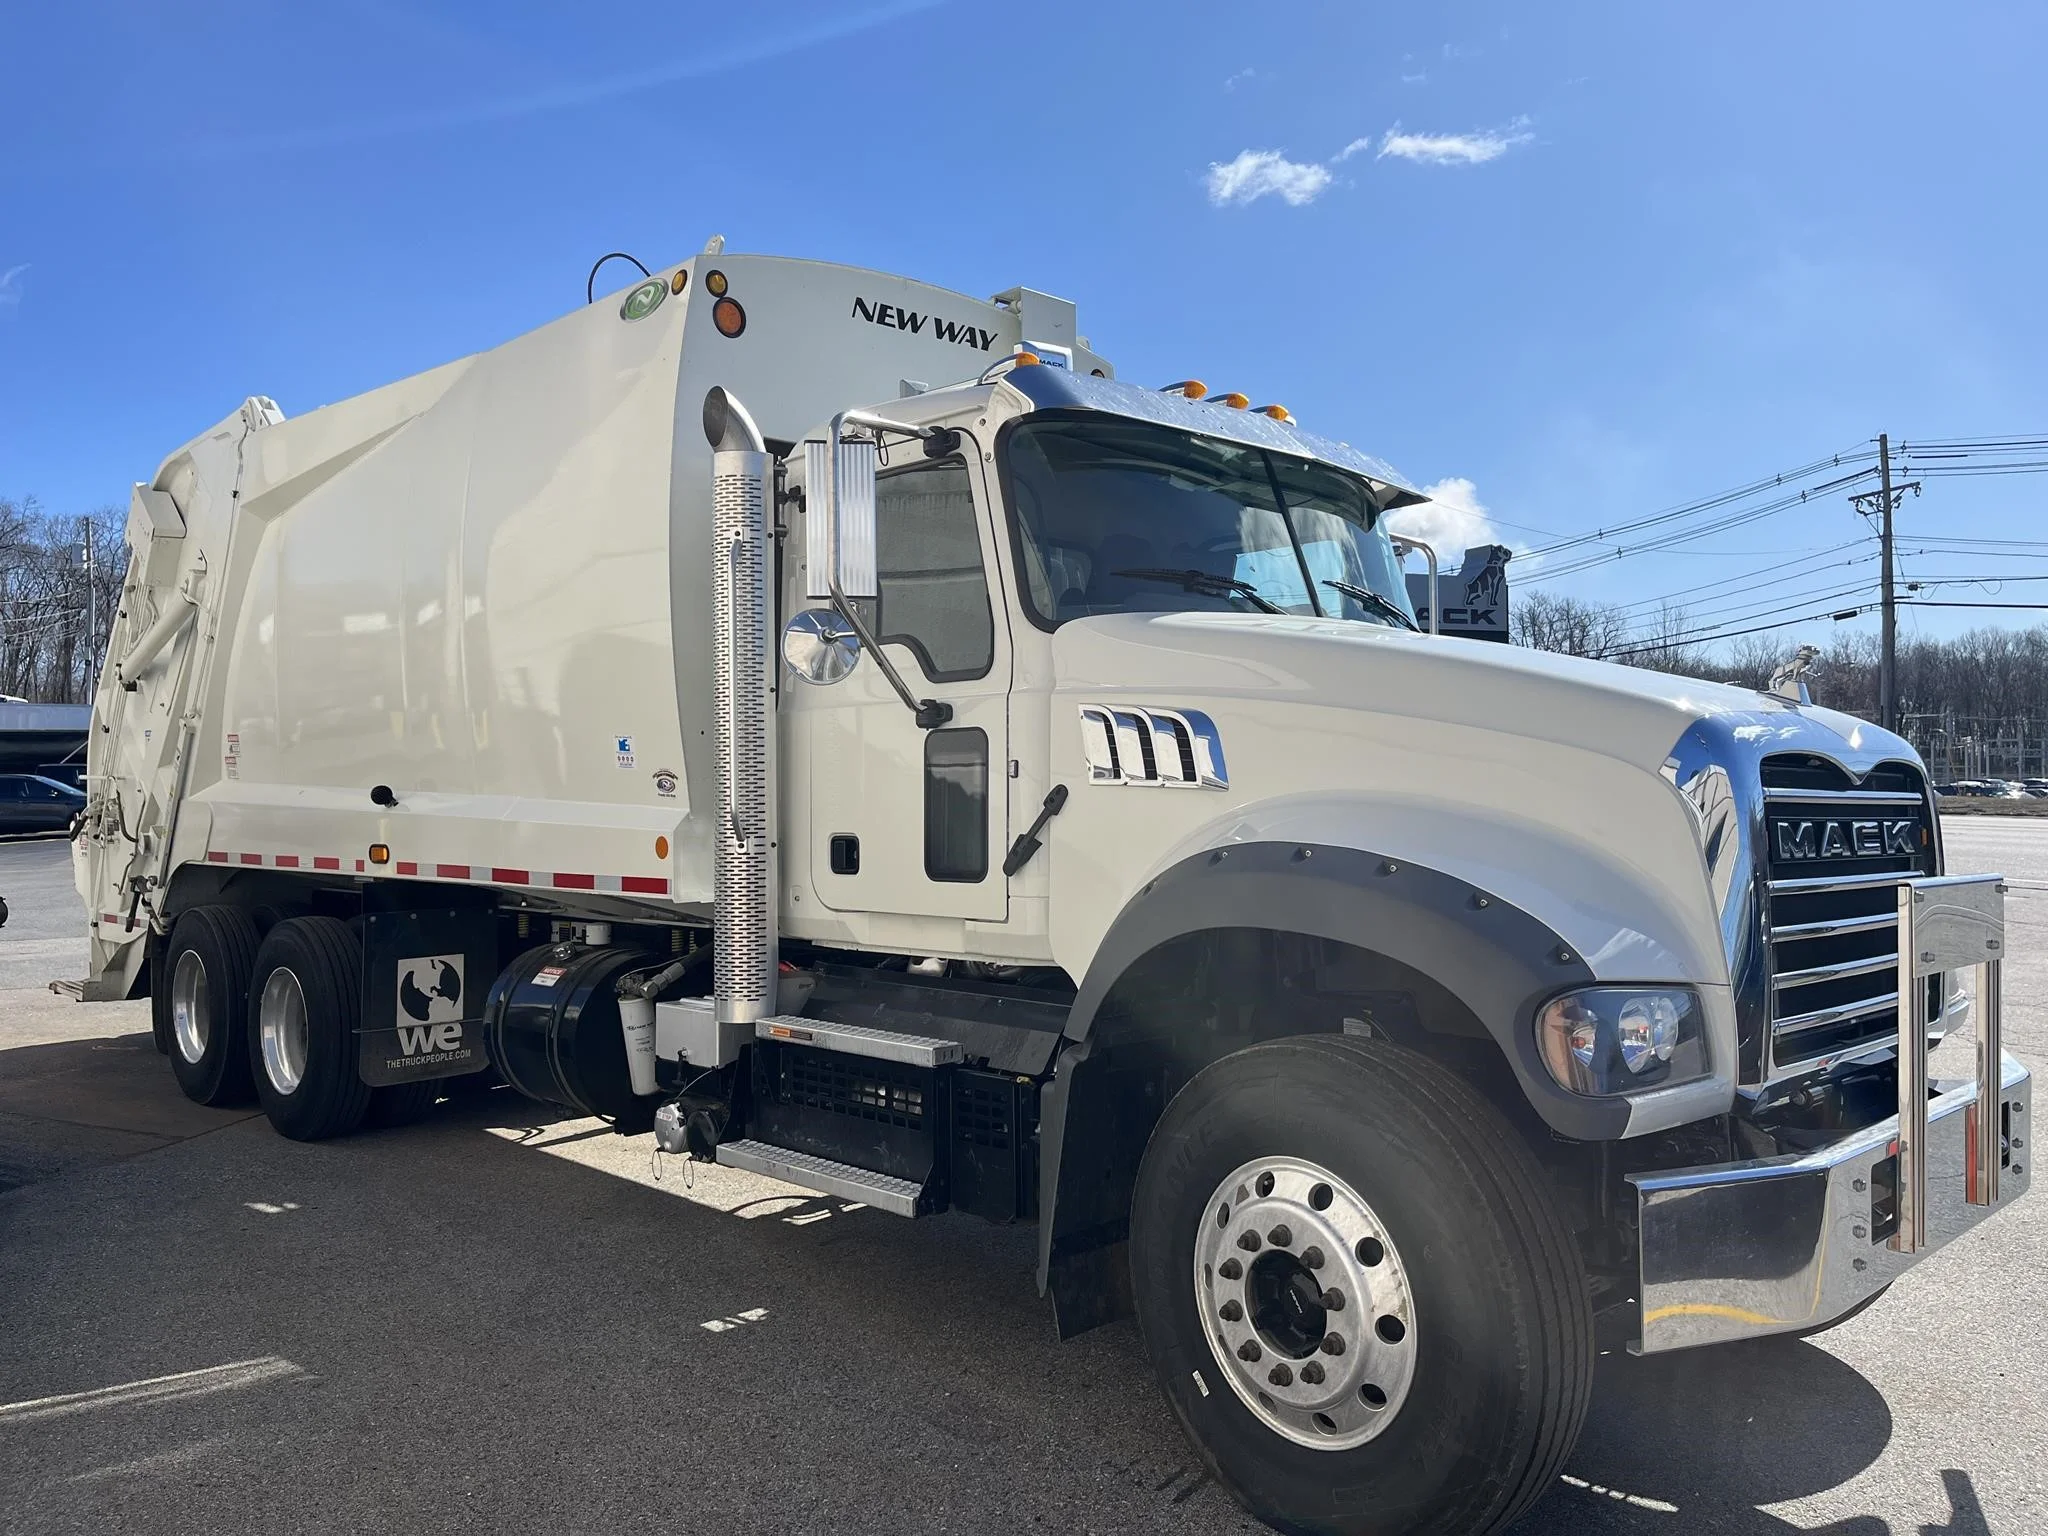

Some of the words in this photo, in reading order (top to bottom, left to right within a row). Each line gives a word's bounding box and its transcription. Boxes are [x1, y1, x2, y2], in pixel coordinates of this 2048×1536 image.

[851, 296, 928, 334] NEW
[933, 317, 998, 351] WAY
[1039, 359, 1064, 369] MACK
[1415, 607, 1497, 625] ACK
[1777, 821, 1915, 859] MACK
[397, 1021, 463, 1056] we
[386, 1049, 472, 1069] THETRUCKPEOPLE.COM
